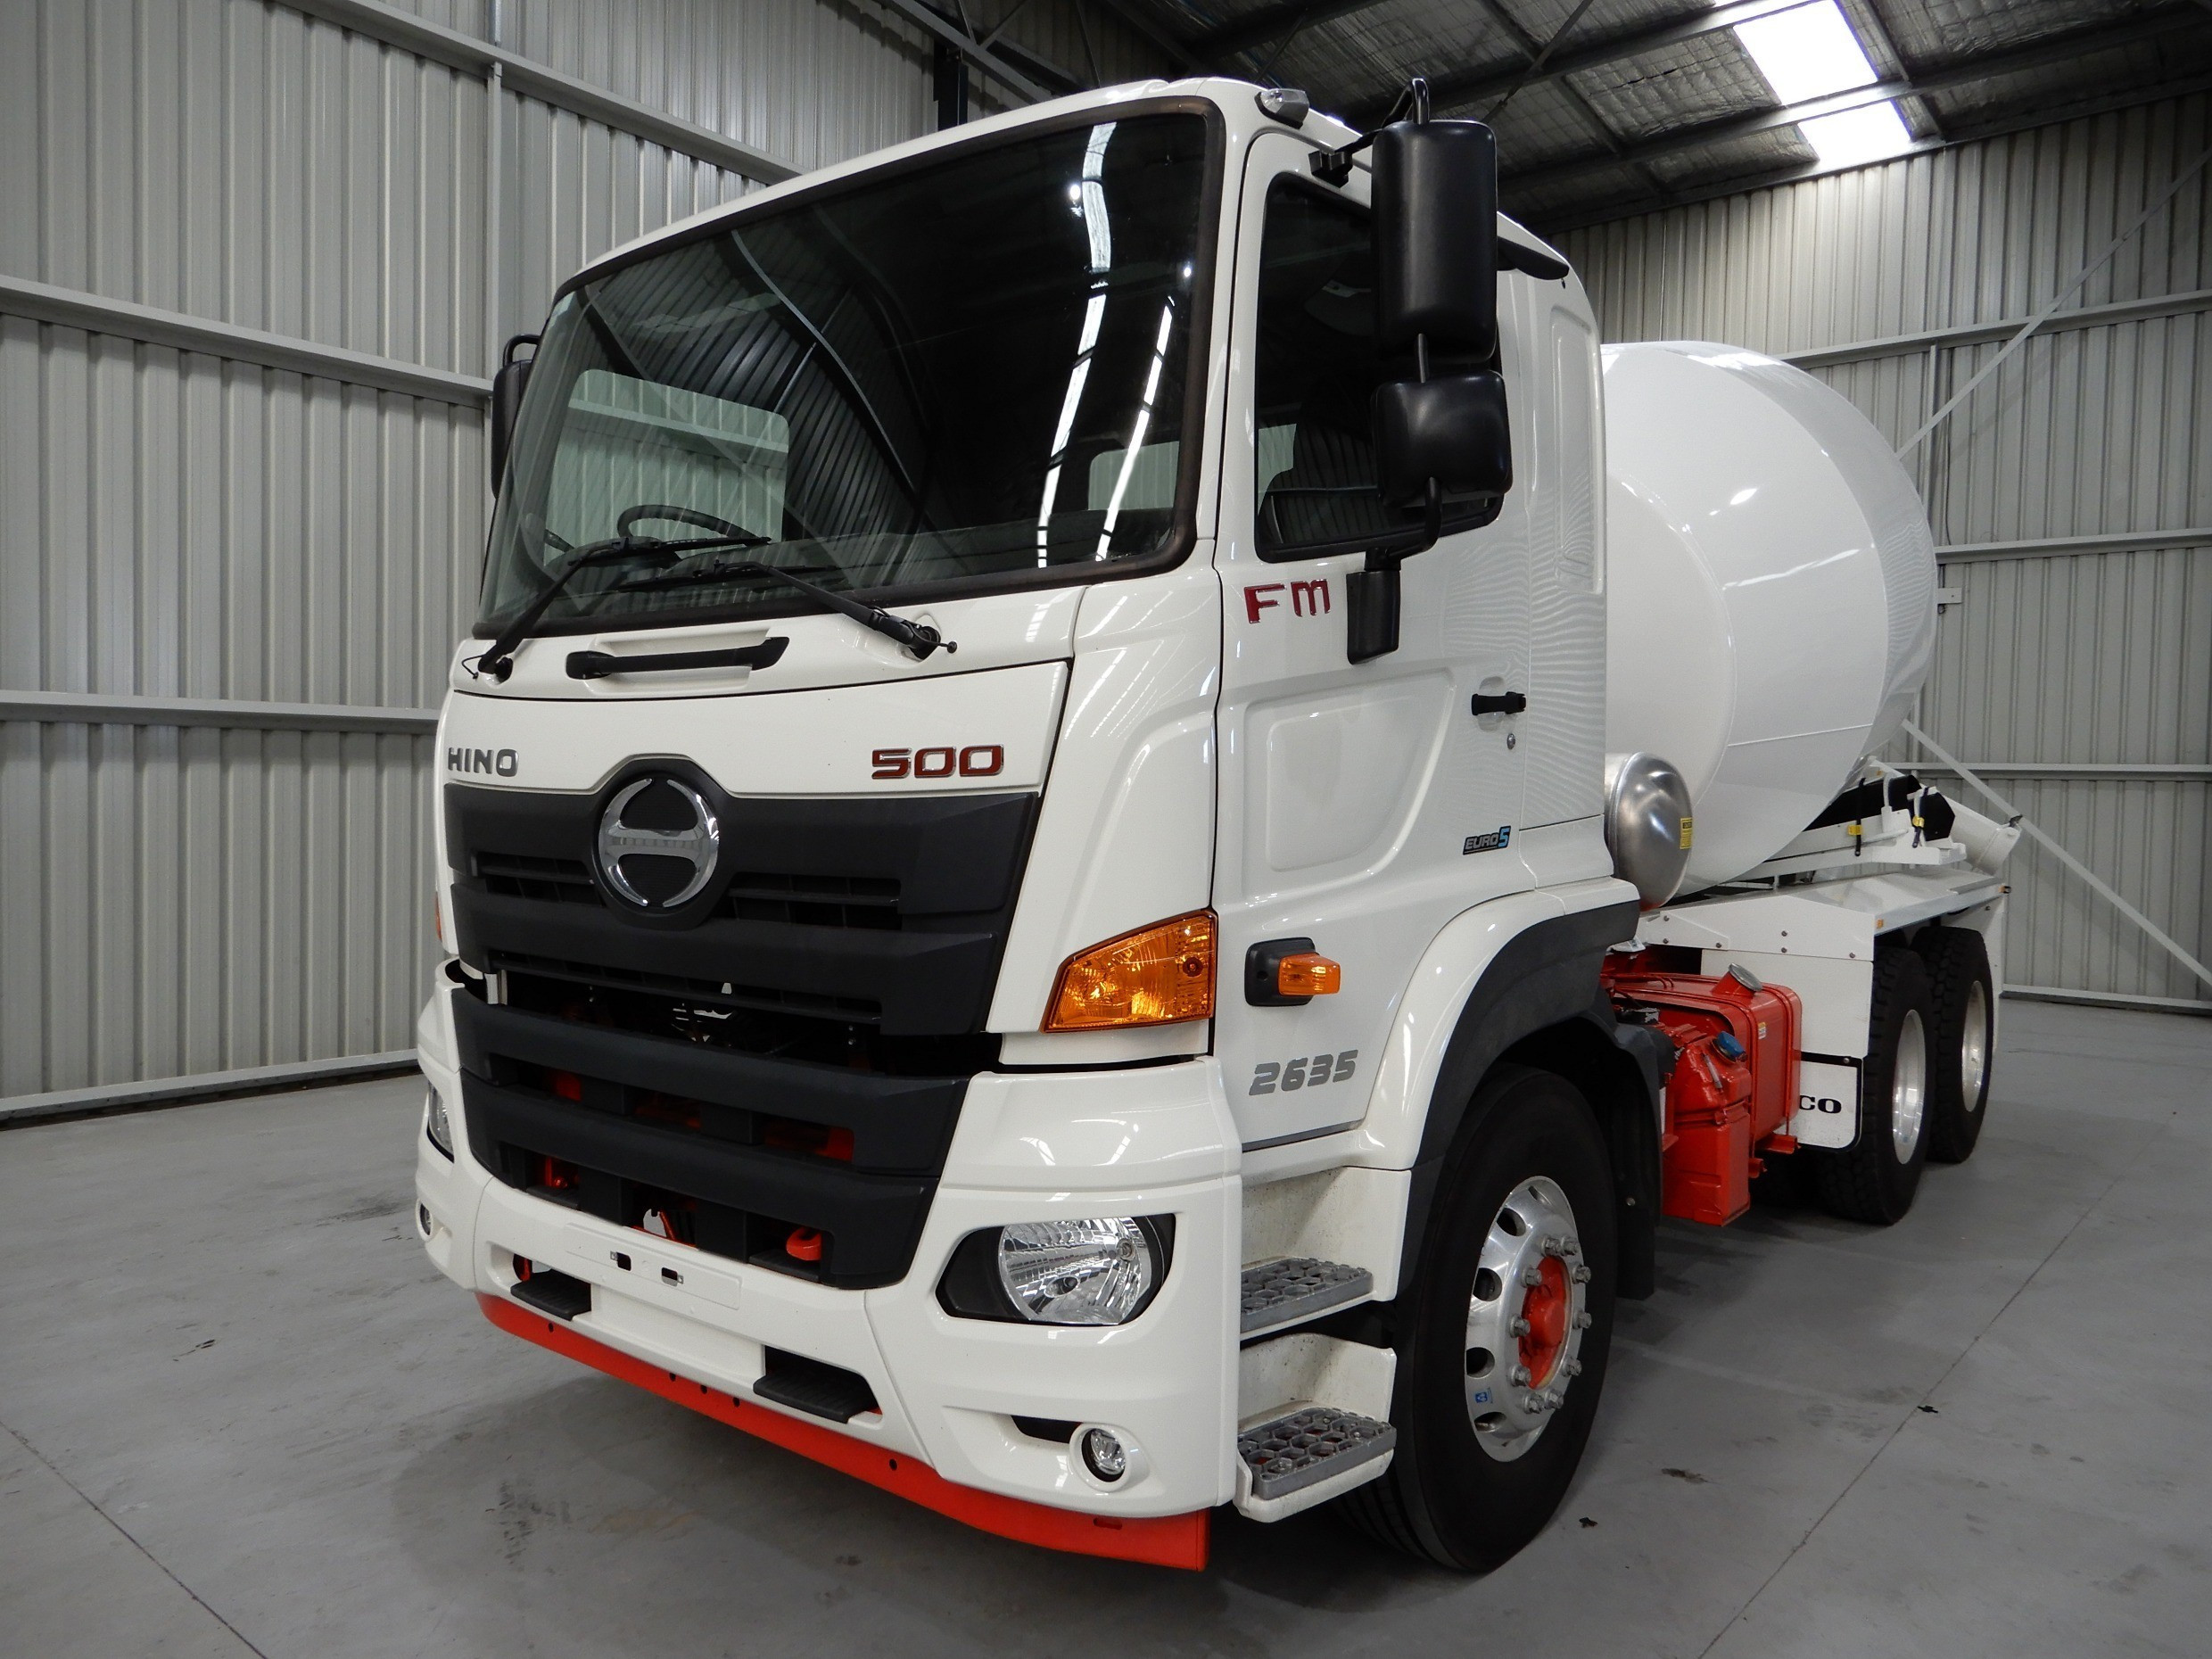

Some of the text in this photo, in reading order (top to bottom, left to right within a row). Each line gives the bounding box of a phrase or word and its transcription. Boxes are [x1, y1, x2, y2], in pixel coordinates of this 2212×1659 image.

[1244, 579, 1331, 624] FM
[448, 747, 519, 777] HINO
[871, 744, 1004, 780] 500
[1249, 1049, 1358, 1096] 2635
